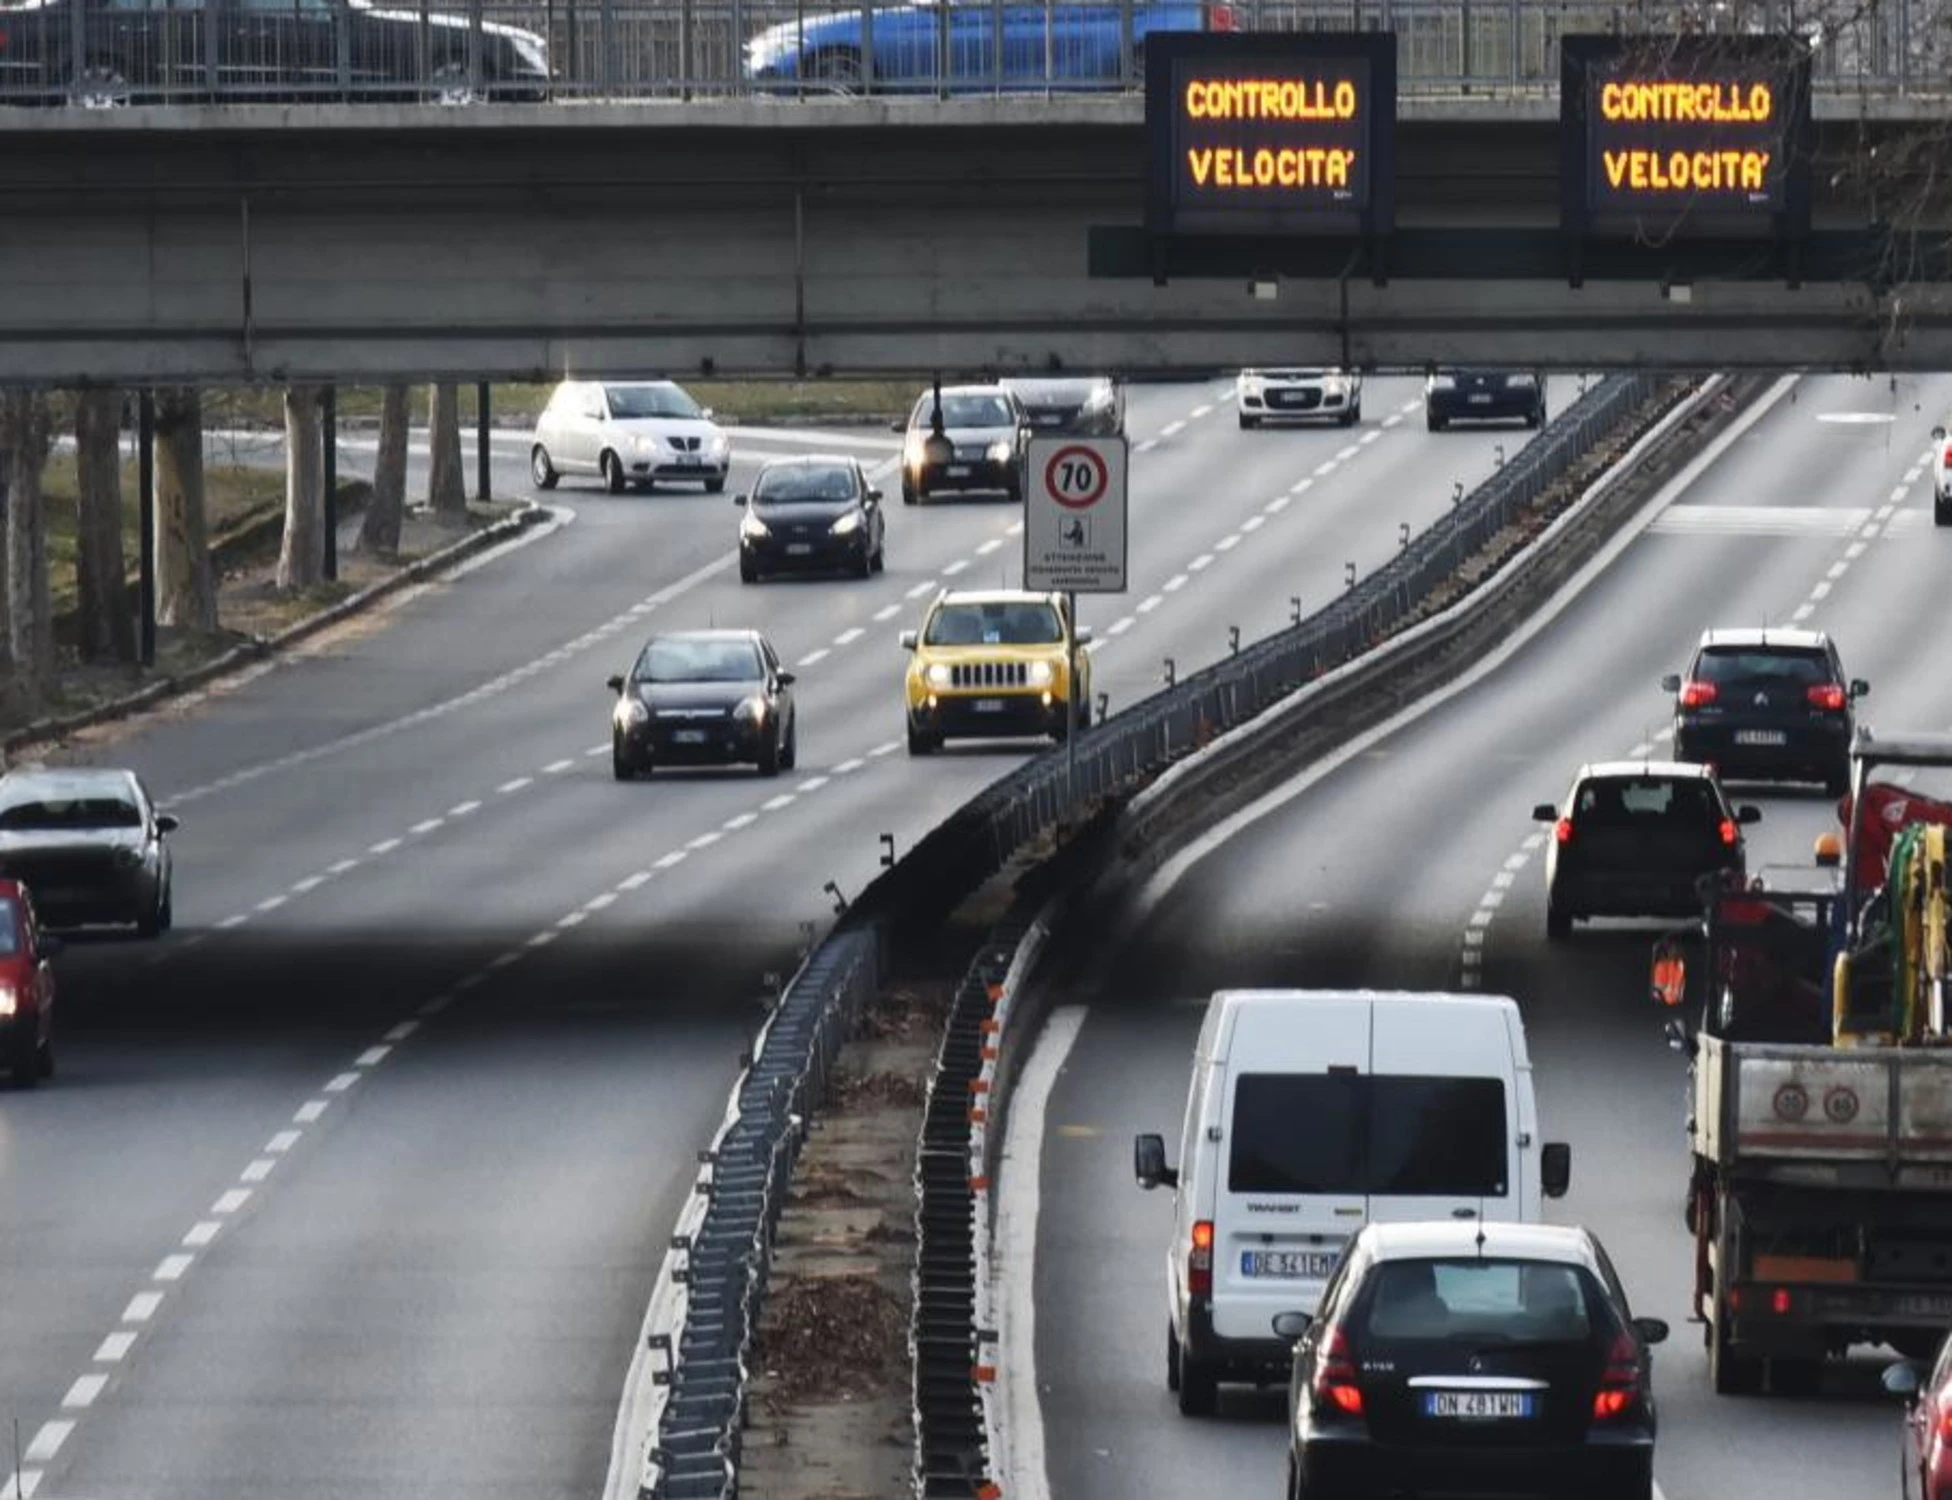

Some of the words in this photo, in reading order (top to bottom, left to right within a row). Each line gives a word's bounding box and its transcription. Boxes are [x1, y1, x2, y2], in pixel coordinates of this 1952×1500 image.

[1186, 80, 1355, 119] CONTROLLO
[1601, 83, 1771, 121] CONTROLLO
[1188, 148, 1355, 186] VELOCITA'
[1603, 151, 1770, 189] VELOCITA'
[1061, 462, 1092, 492] 70
